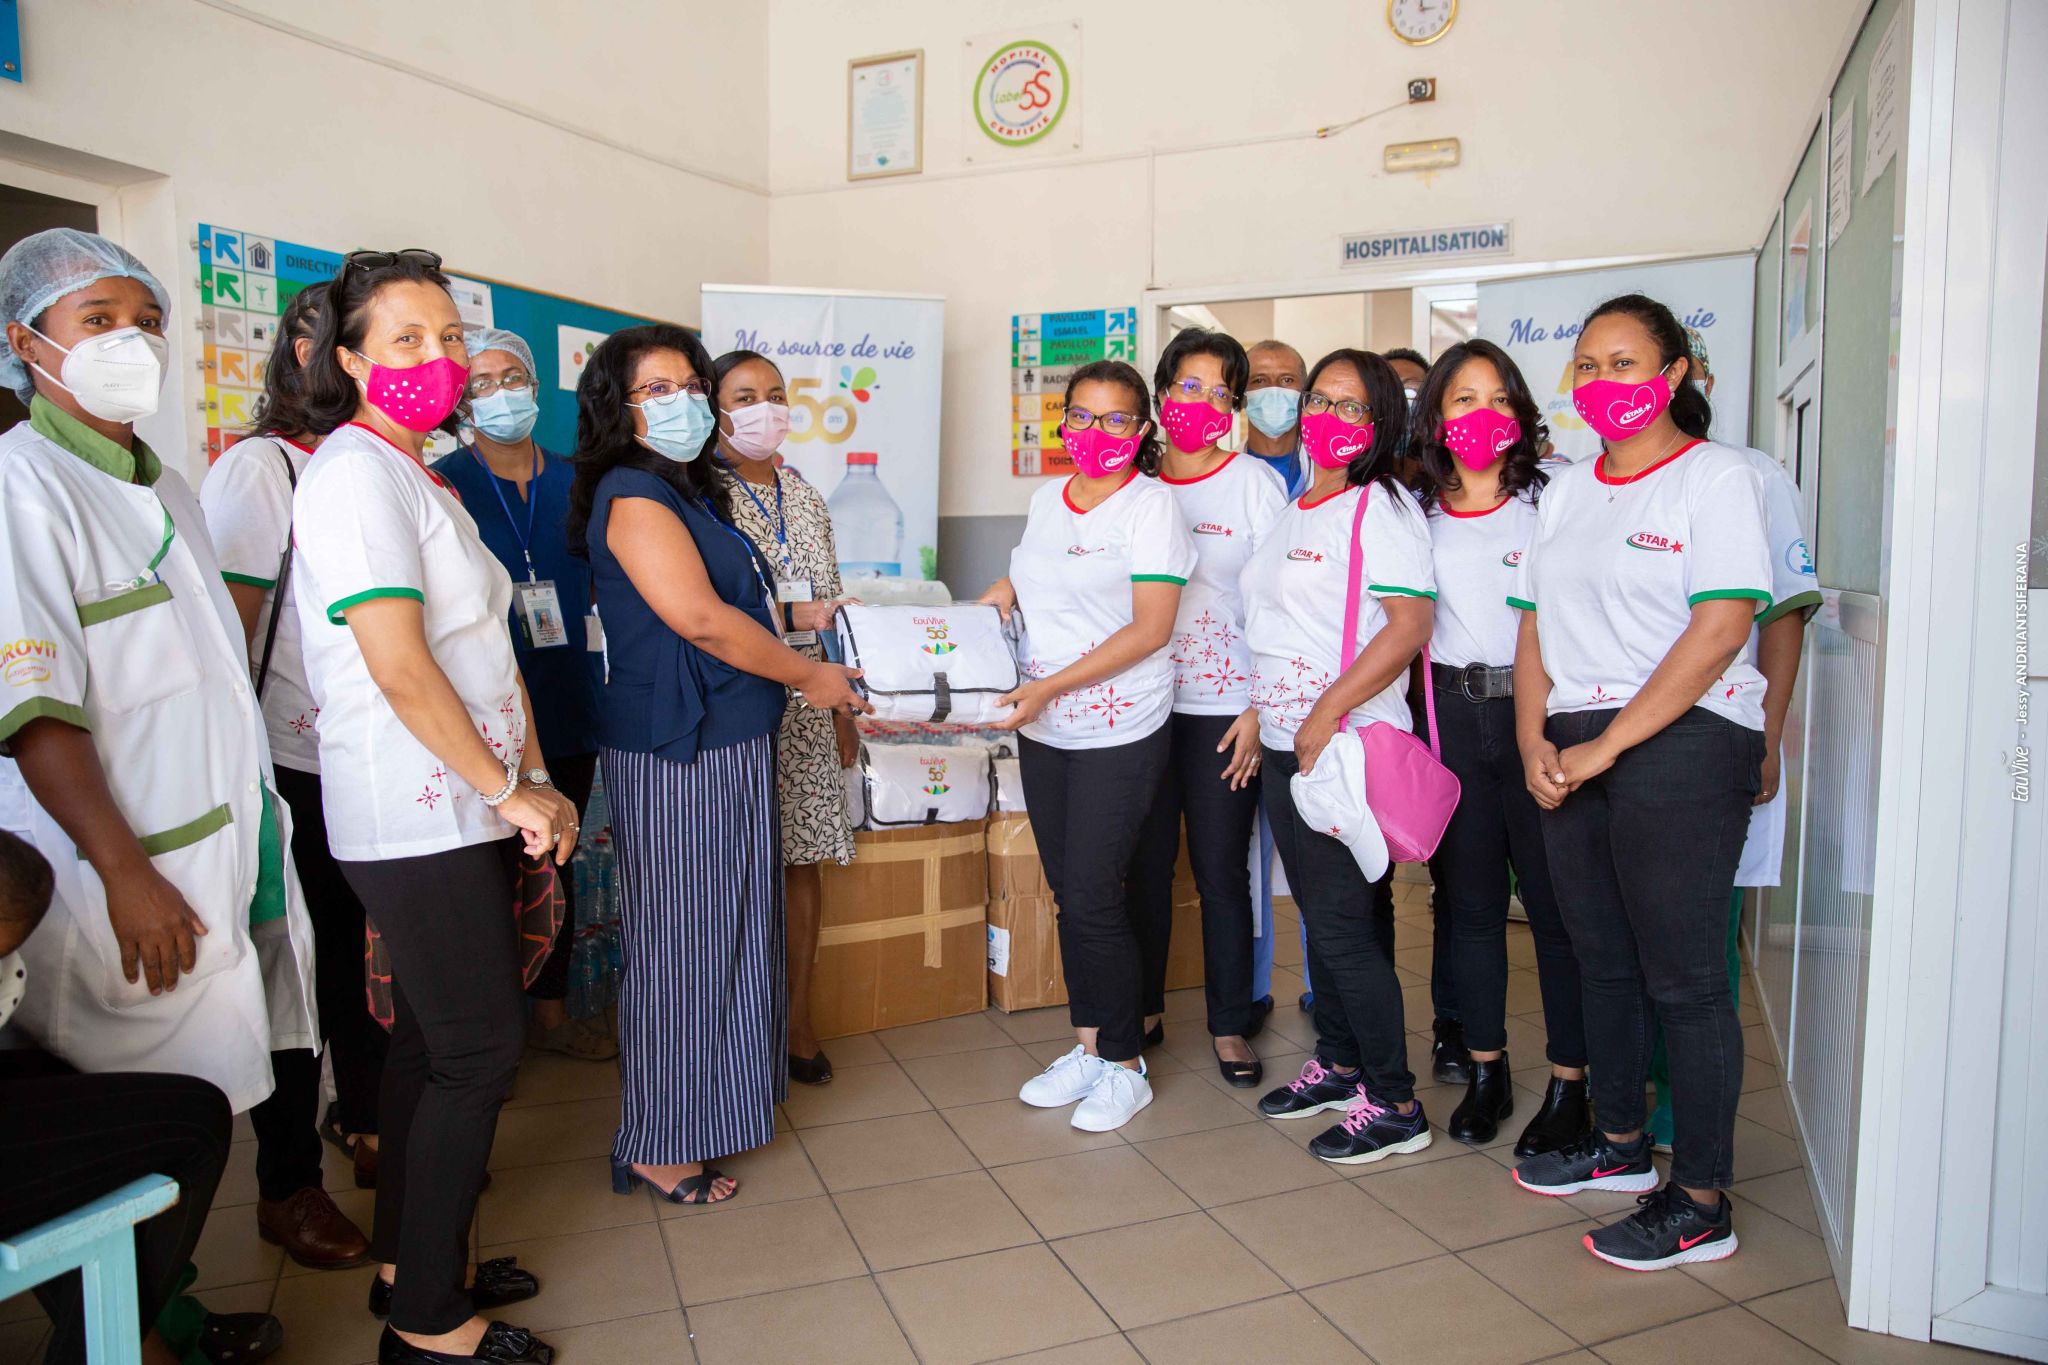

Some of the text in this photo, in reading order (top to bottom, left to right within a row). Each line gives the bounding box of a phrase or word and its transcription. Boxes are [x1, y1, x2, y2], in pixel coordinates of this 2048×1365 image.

[1345, 229, 1504, 260] HOSPITALISATION
[1506, 317, 1549, 347] Ma
[735, 329, 916, 360] Ma source de vie
[1201, 523, 1223, 532] STAR
[1638, 533, 1669, 548] STAR
[1294, 549, 1313, 559] STAR
